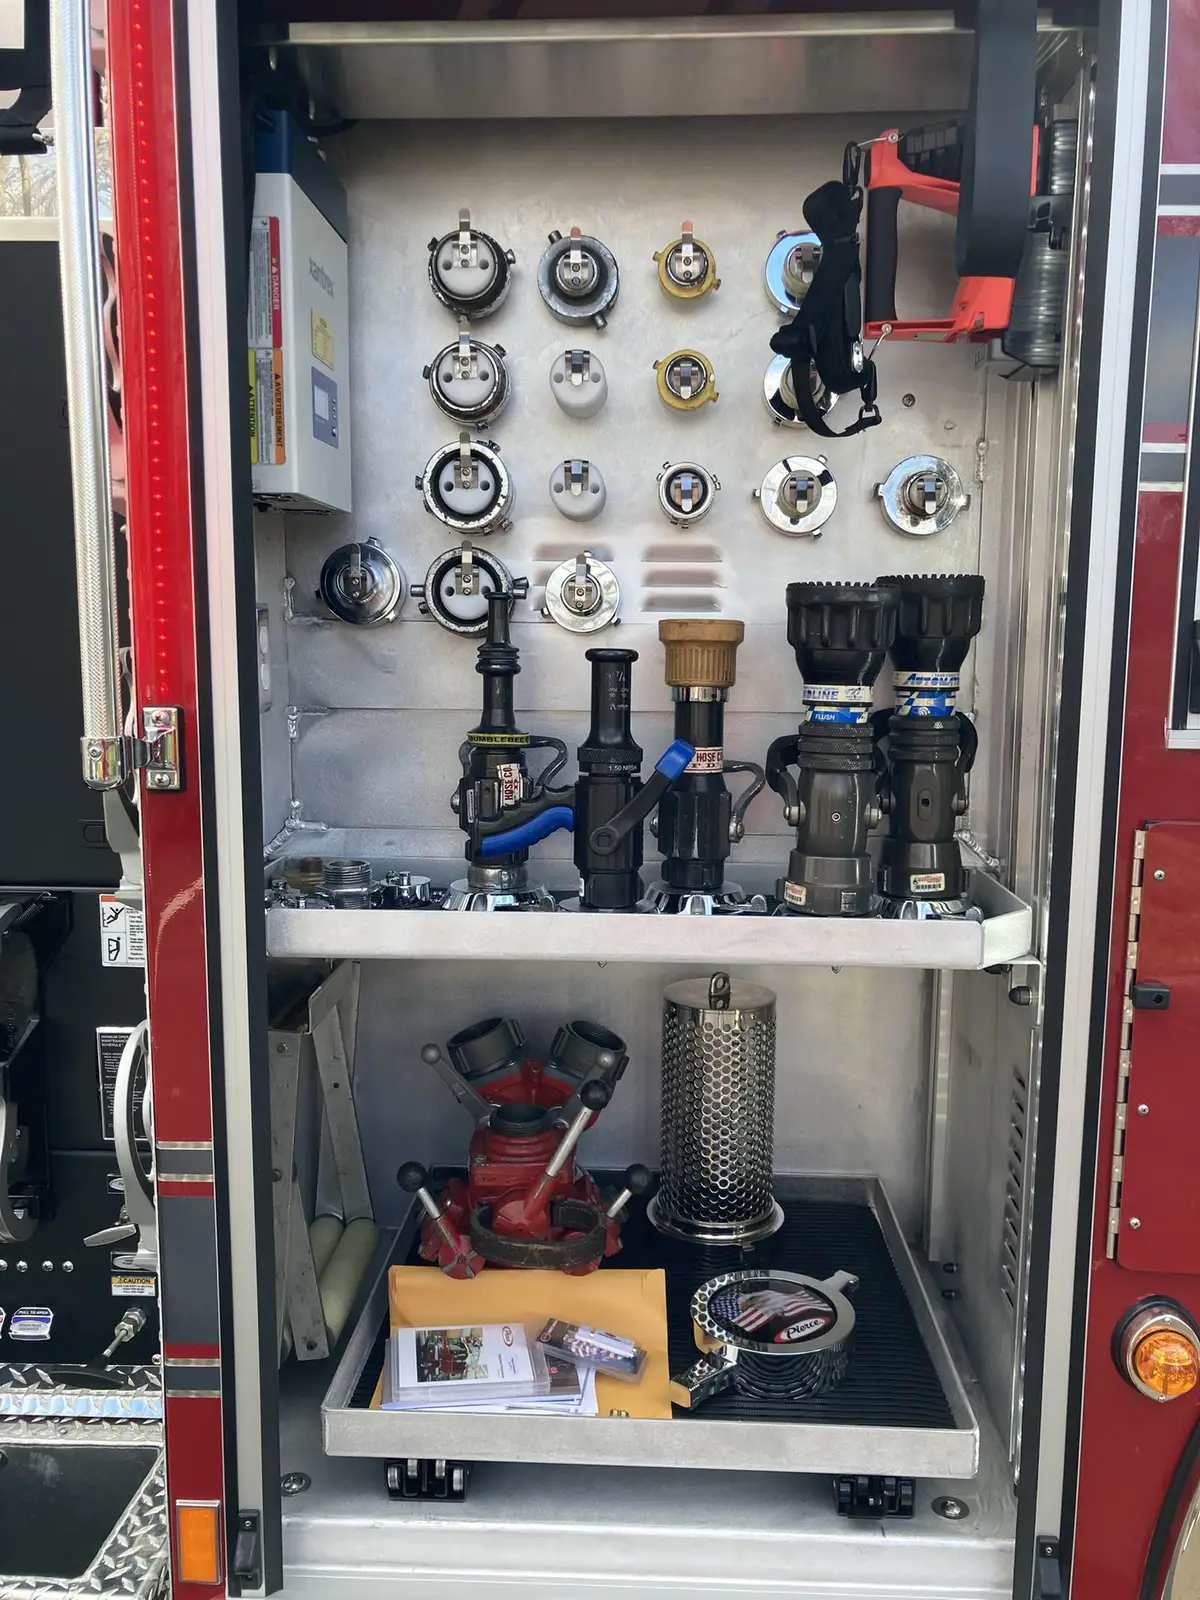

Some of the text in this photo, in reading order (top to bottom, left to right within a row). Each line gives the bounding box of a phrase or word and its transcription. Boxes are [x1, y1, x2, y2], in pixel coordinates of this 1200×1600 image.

[272, 276, 280, 310] DANGER
[249, 393, 257, 437] ATTENTION
[275, 382, 284, 447] AVERTISSEMENT
[814, 713, 836, 721] FLUSH
[696, 752, 716, 762] HOSE
[504, 779, 514, 801] HOSE
[785, 1318, 821, 1339] Pierce
